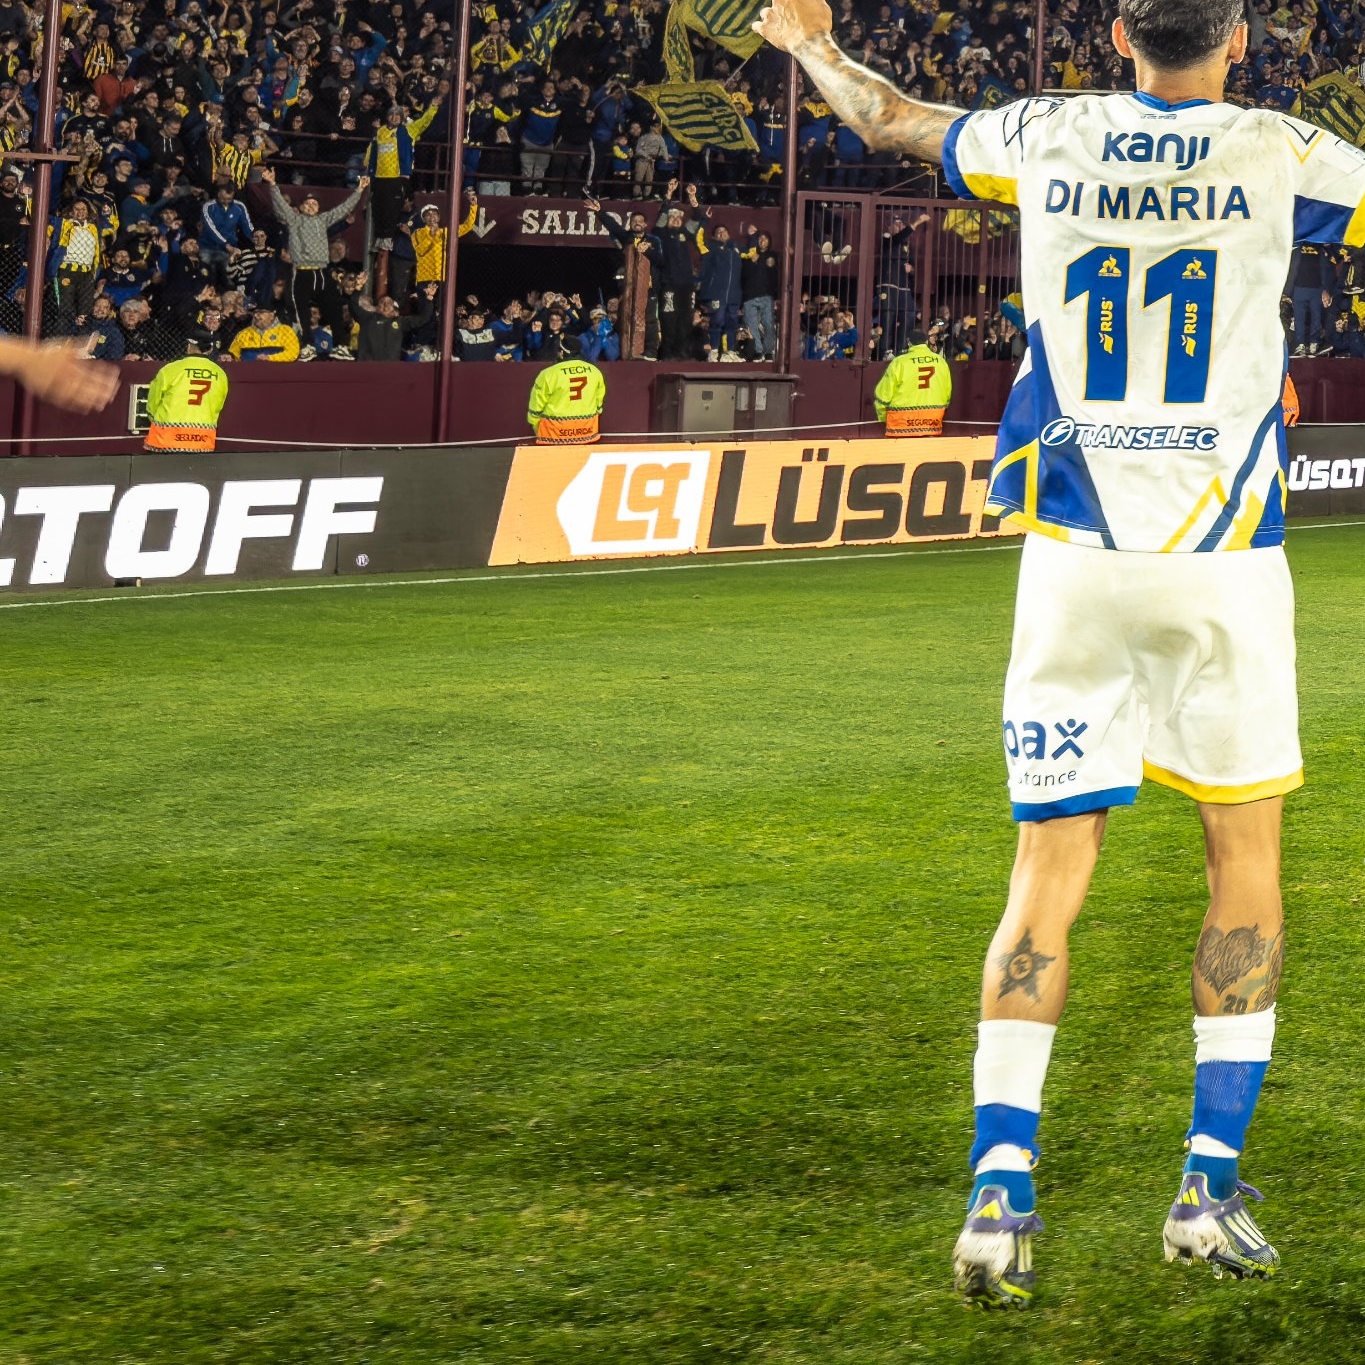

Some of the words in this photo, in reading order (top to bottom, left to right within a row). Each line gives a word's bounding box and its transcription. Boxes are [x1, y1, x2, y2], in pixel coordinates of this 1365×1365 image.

[1045, 179, 1084, 216] DI
[1097, 184, 1251, 221] MARIA
[521, 208, 633, 235] SALI
[1063, 244, 1220, 405] 11
[561, 366, 592, 375] TECH
[911, 356, 939, 364] TECH
[184, 368, 218, 380] TECH
[1074, 423, 1220, 450] TRANSELEC
[708, 448, 998, 549] LÜSQ
[0, 477, 384, 586] TOFF
[1018, 770, 1077, 787] tance
